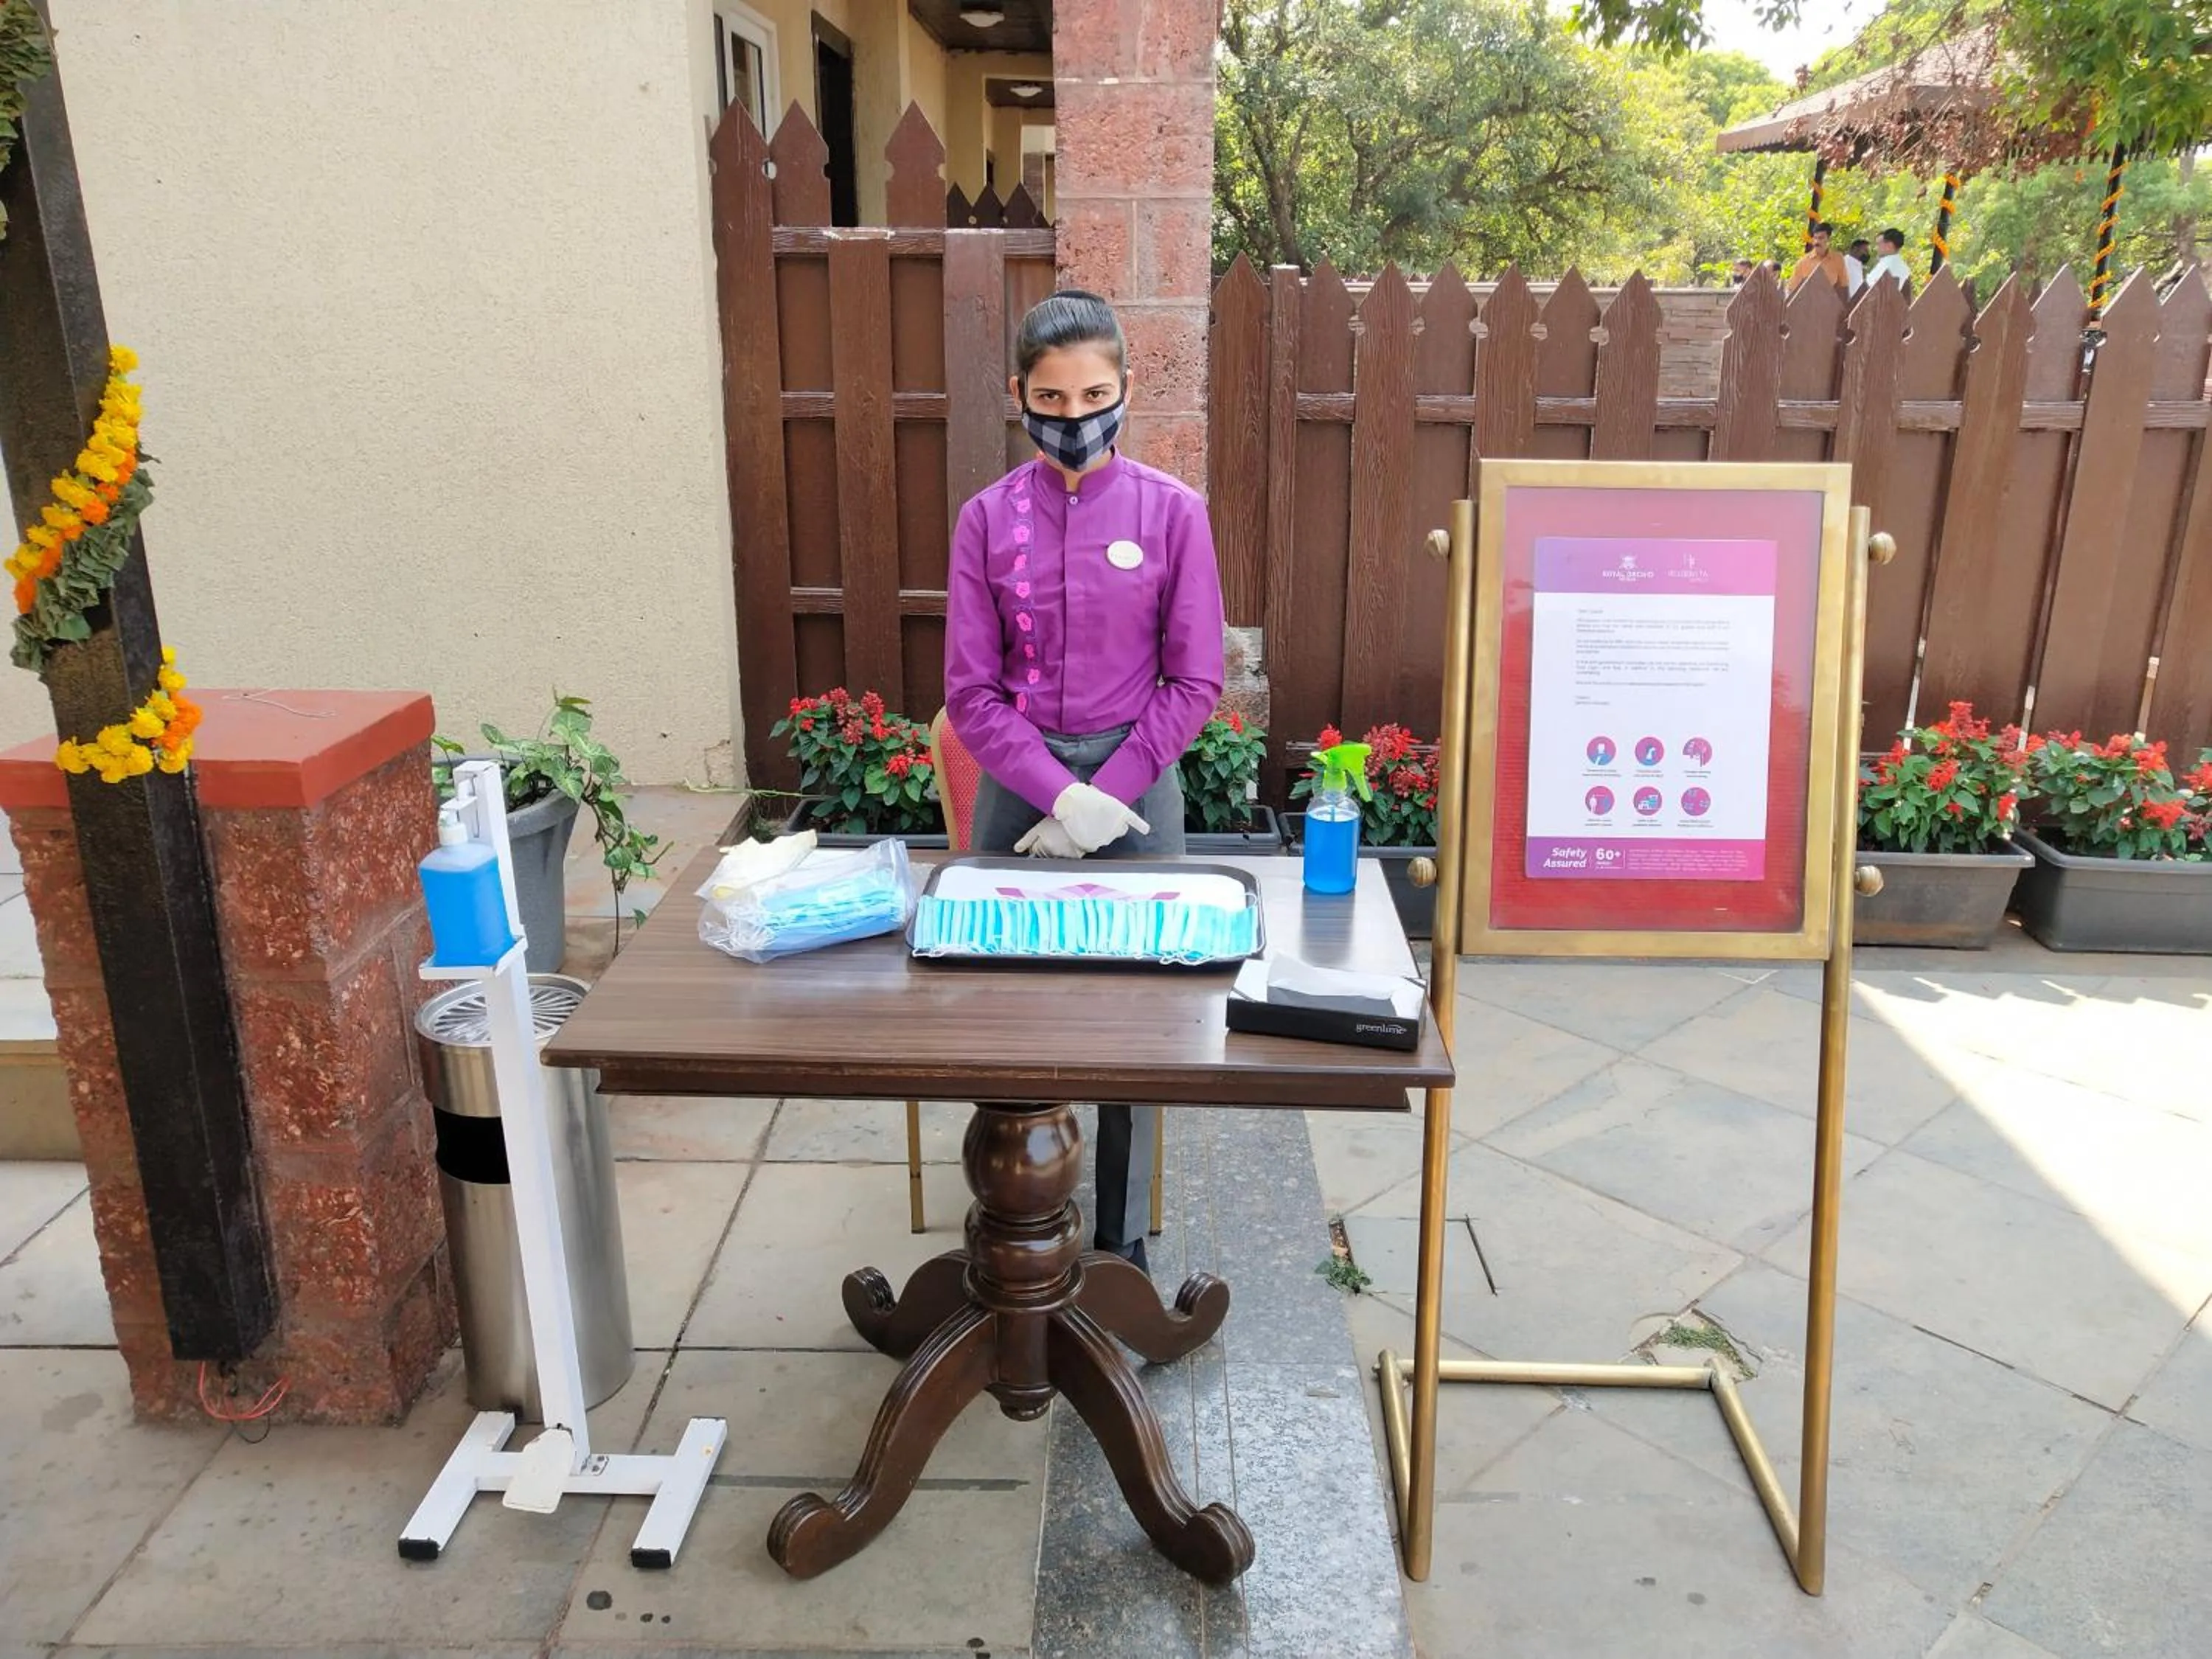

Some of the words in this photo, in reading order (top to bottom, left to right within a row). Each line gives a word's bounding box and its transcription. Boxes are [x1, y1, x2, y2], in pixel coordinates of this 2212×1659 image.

[1551, 847, 1587, 860] Safety
[1596, 847, 1622, 861] 60+
[1543, 858, 1587, 868] Assured
